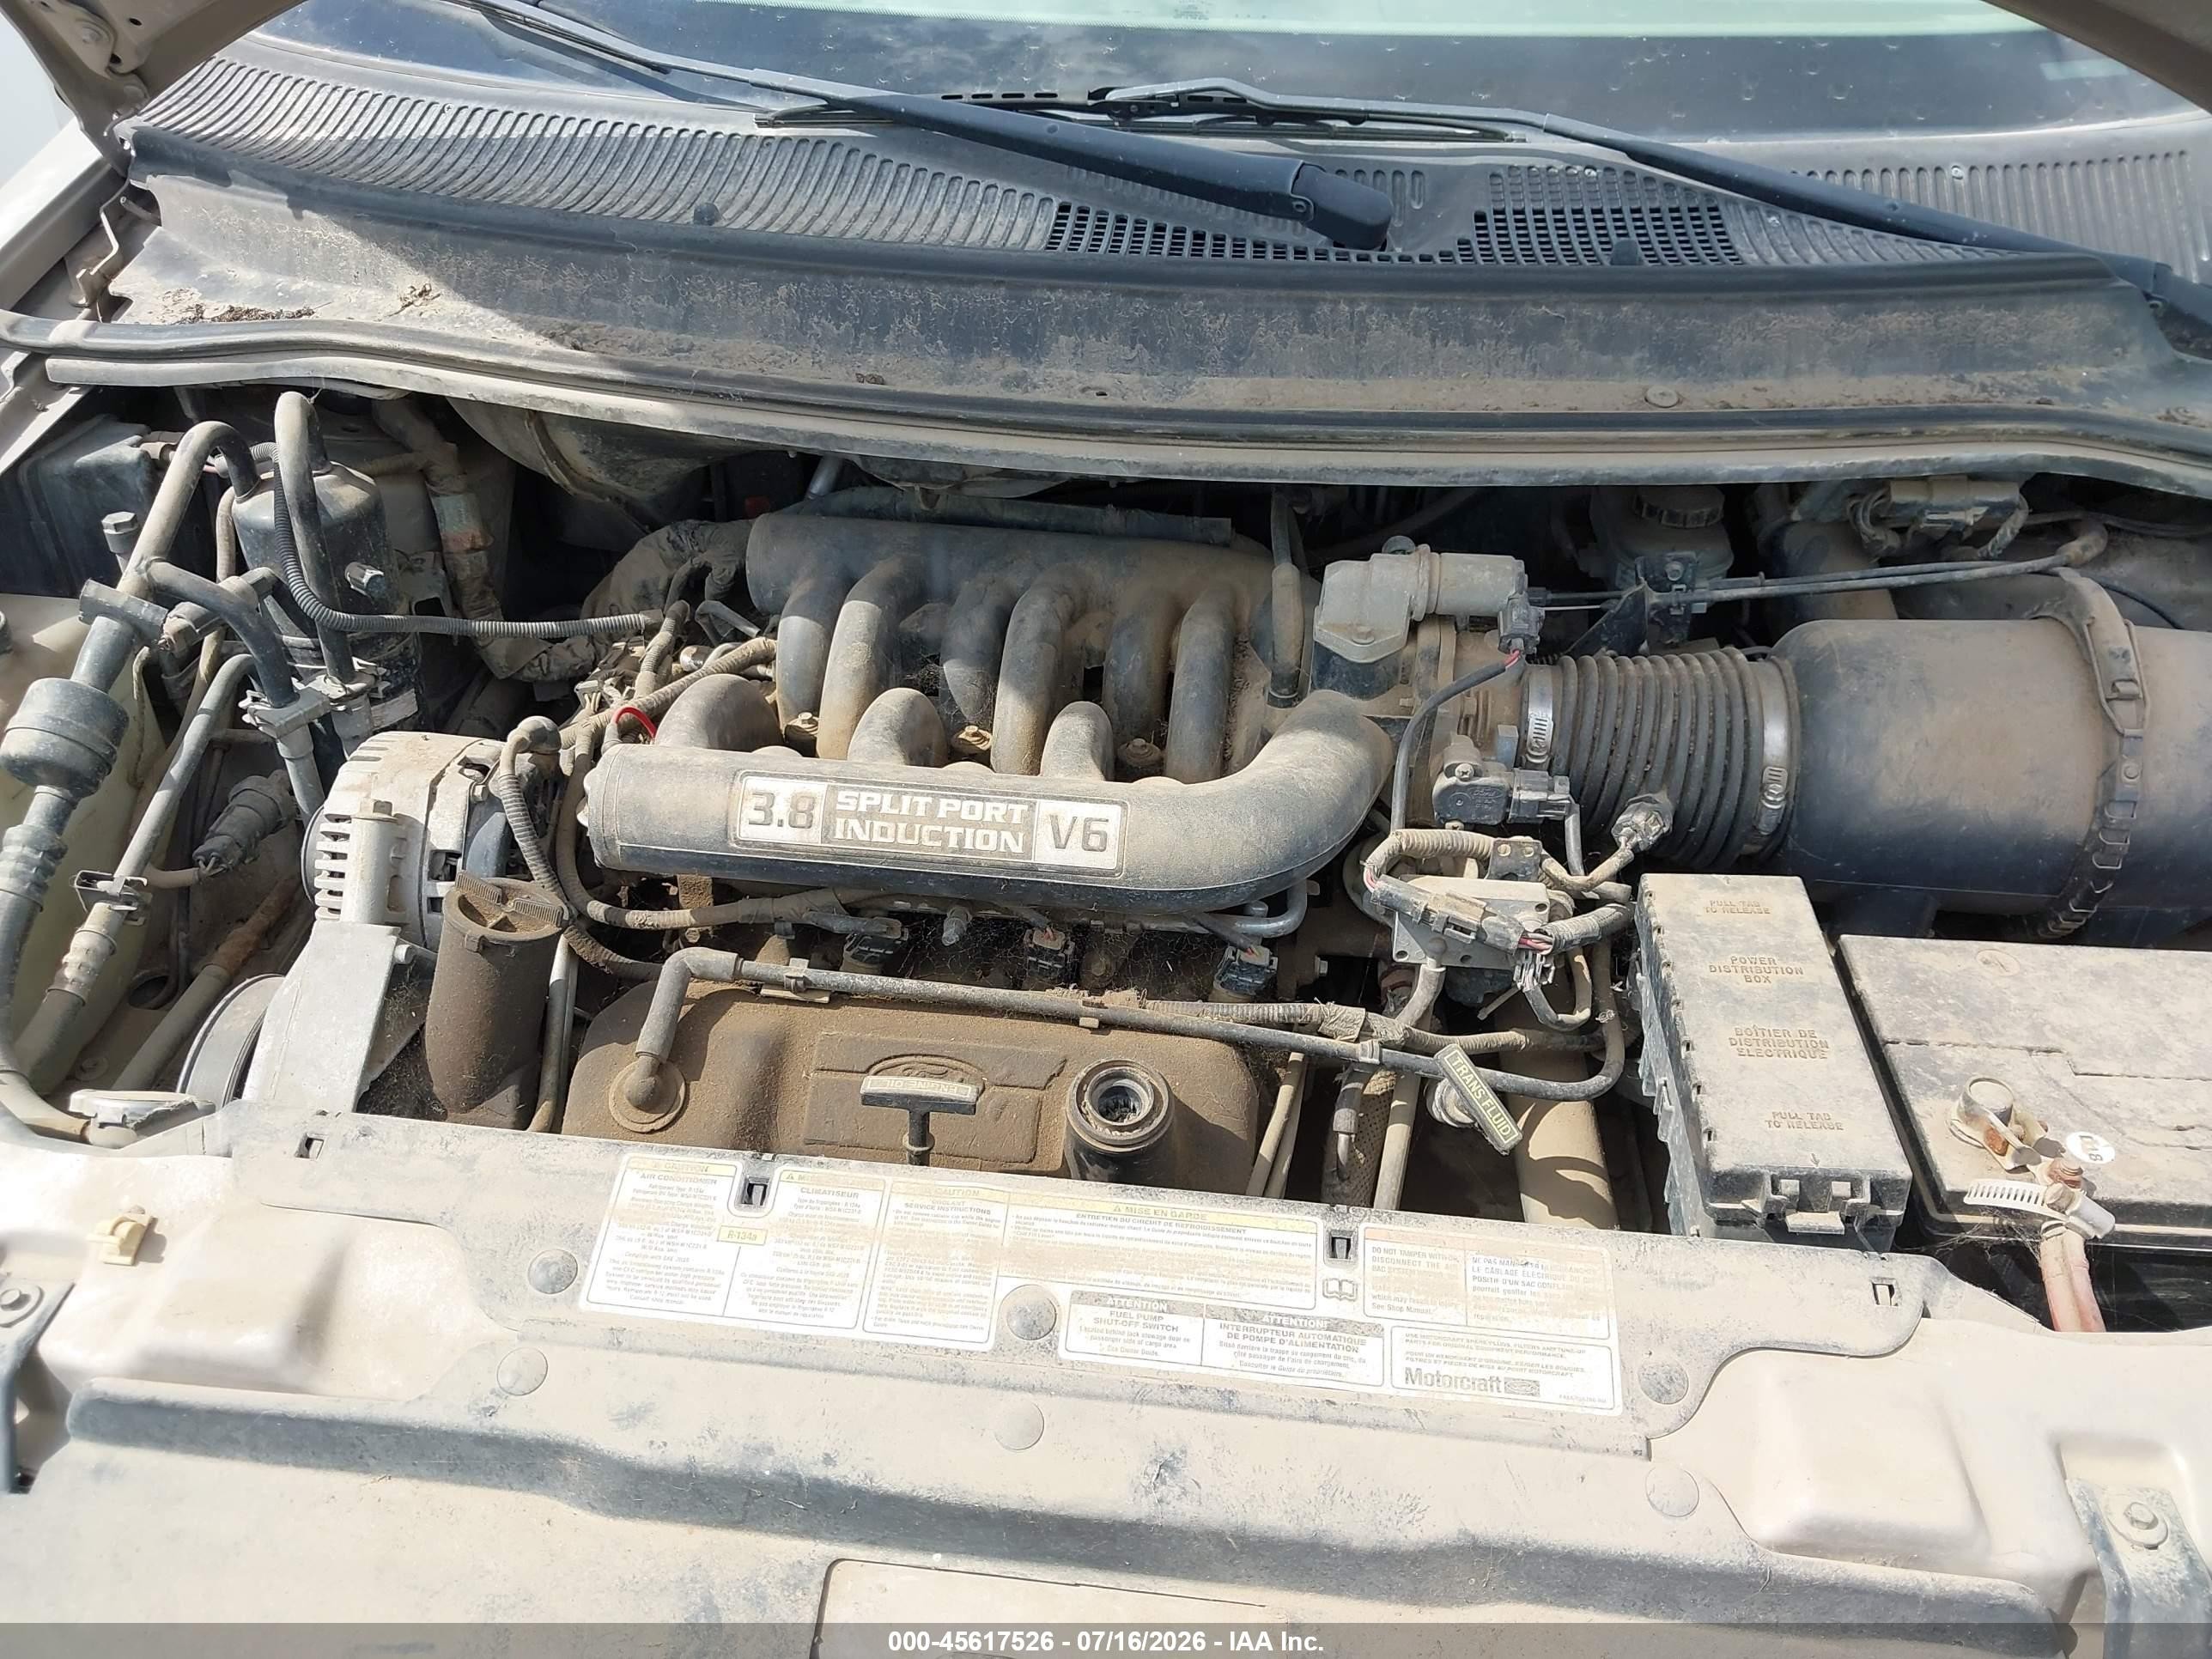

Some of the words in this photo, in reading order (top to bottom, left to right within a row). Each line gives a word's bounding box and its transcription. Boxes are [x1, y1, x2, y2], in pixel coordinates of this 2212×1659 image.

[747, 791, 817, 830] 3.8
[836, 790, 933, 816] SPLIT
[937, 798, 1027, 824] PORT
[834, 818, 1025, 854] INDUCTION
[1048, 813, 1109, 852] V6
[1730, 956, 1778, 966] POWER
[1709, 964, 1804, 975] DISTRIBUTION
[1744, 975, 1771, 983] BOX
[1735, 1025, 1792, 1038] BOÎTIER
[1799, 1029, 1817, 1039] DE
[1729, 1037, 1829, 1049] DISTRIBUTION
[906, 1080, 957, 1093] ENGINE
[1452, 1055, 1486, 1100] TRANS
[1481, 1098, 1513, 1137] FLUID
[1771, 1111, 1805, 1121] PULL
[1765, 1120, 1782, 1128] TO
[800, 1187, 859, 1199] CLIMATISEUR
[904, 1201, 934, 1210] SERVICE
[936, 1204, 991, 1215] INSTRUCTIONS
[1124, 1206, 1151, 1215] MISE
[1170, 1210, 1207, 1219] GARDE
[1076, 1212, 1117, 1222] ENTRETIEN
[1175, 1222, 1246, 1234] REFROIDISSEMENT
[727, 1230, 757, 1242] R-134a
[1399, 1249, 1426, 1258] TAMPER
[1372, 1255, 1422, 1267] DISCONNECT
[1106, 1297, 1168, 1311] ATTENTION
[1387, 1304, 1403, 1312] Shop
[1109, 1310, 1133, 1319] FUEL
[1135, 1312, 1164, 1322] PUMP
[1261, 1315, 1328, 1329] ATTENTION!
[1093, 1317, 1139, 1328] SHUT-OFF
[1141, 1321, 1178, 1331] SWITCH
[1219, 1322, 1295, 1338] INTERRUPTEUR
[1297, 1330, 1367, 1345] AUTOMATIQUE
[1226, 1332, 1239, 1341] DE
[1242, 1334, 1276, 1345] POMPE
[1279, 1337, 1359, 1352] D'ALIMENTATION
[1405, 1366, 1502, 1393] Motorcraft
